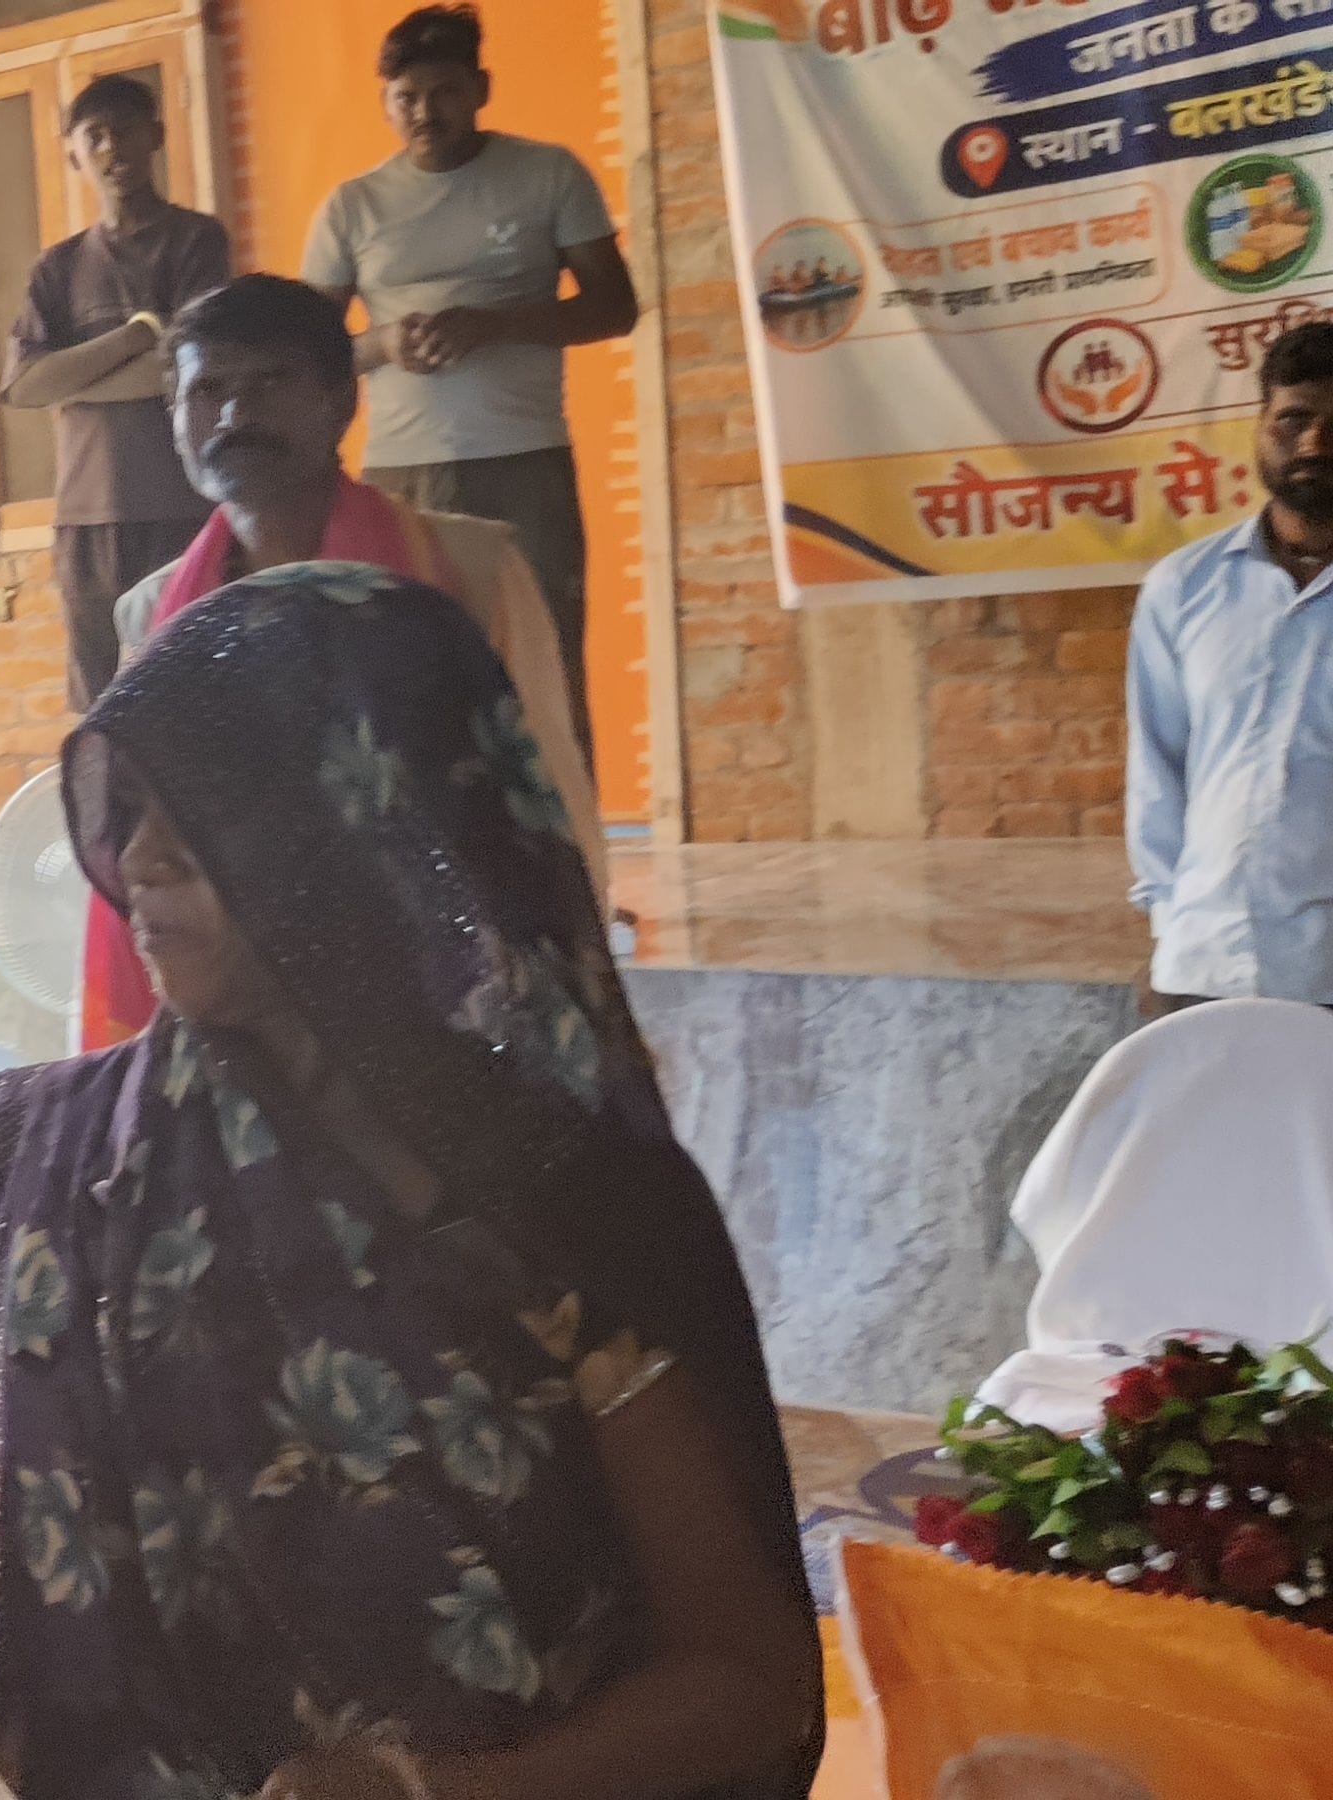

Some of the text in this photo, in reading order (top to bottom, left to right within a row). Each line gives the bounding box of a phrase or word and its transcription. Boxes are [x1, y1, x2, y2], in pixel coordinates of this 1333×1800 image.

[1066, 5, 1199, 73] जनता
[1020, 117, 1124, 169] स्थान
[914, 461, 1139, 538] सौजन्य
